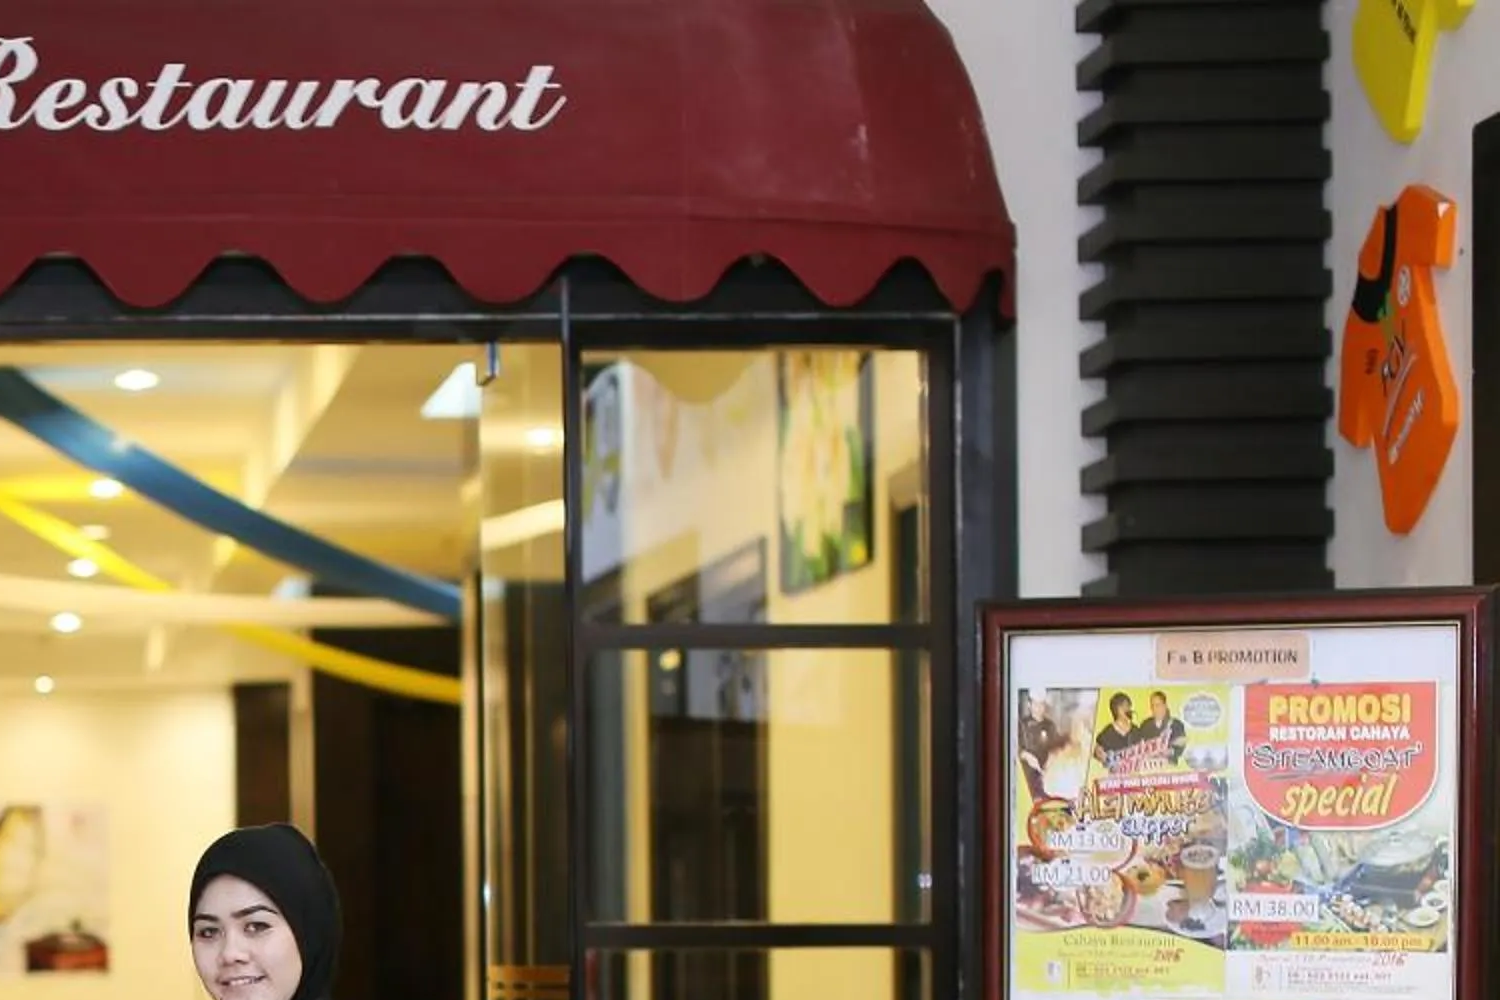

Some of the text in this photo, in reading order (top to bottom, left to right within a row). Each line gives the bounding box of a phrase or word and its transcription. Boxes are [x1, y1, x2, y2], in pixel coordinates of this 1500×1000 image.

[1208, 649, 1298, 665] PROMOTION
[1268, 693, 1412, 725] PROMOSI
[1269, 725, 1411, 742] RESTORAN CAHAYA
[1281, 772, 1398, 825] special
[1232, 900, 1315, 917] RM 38.00
